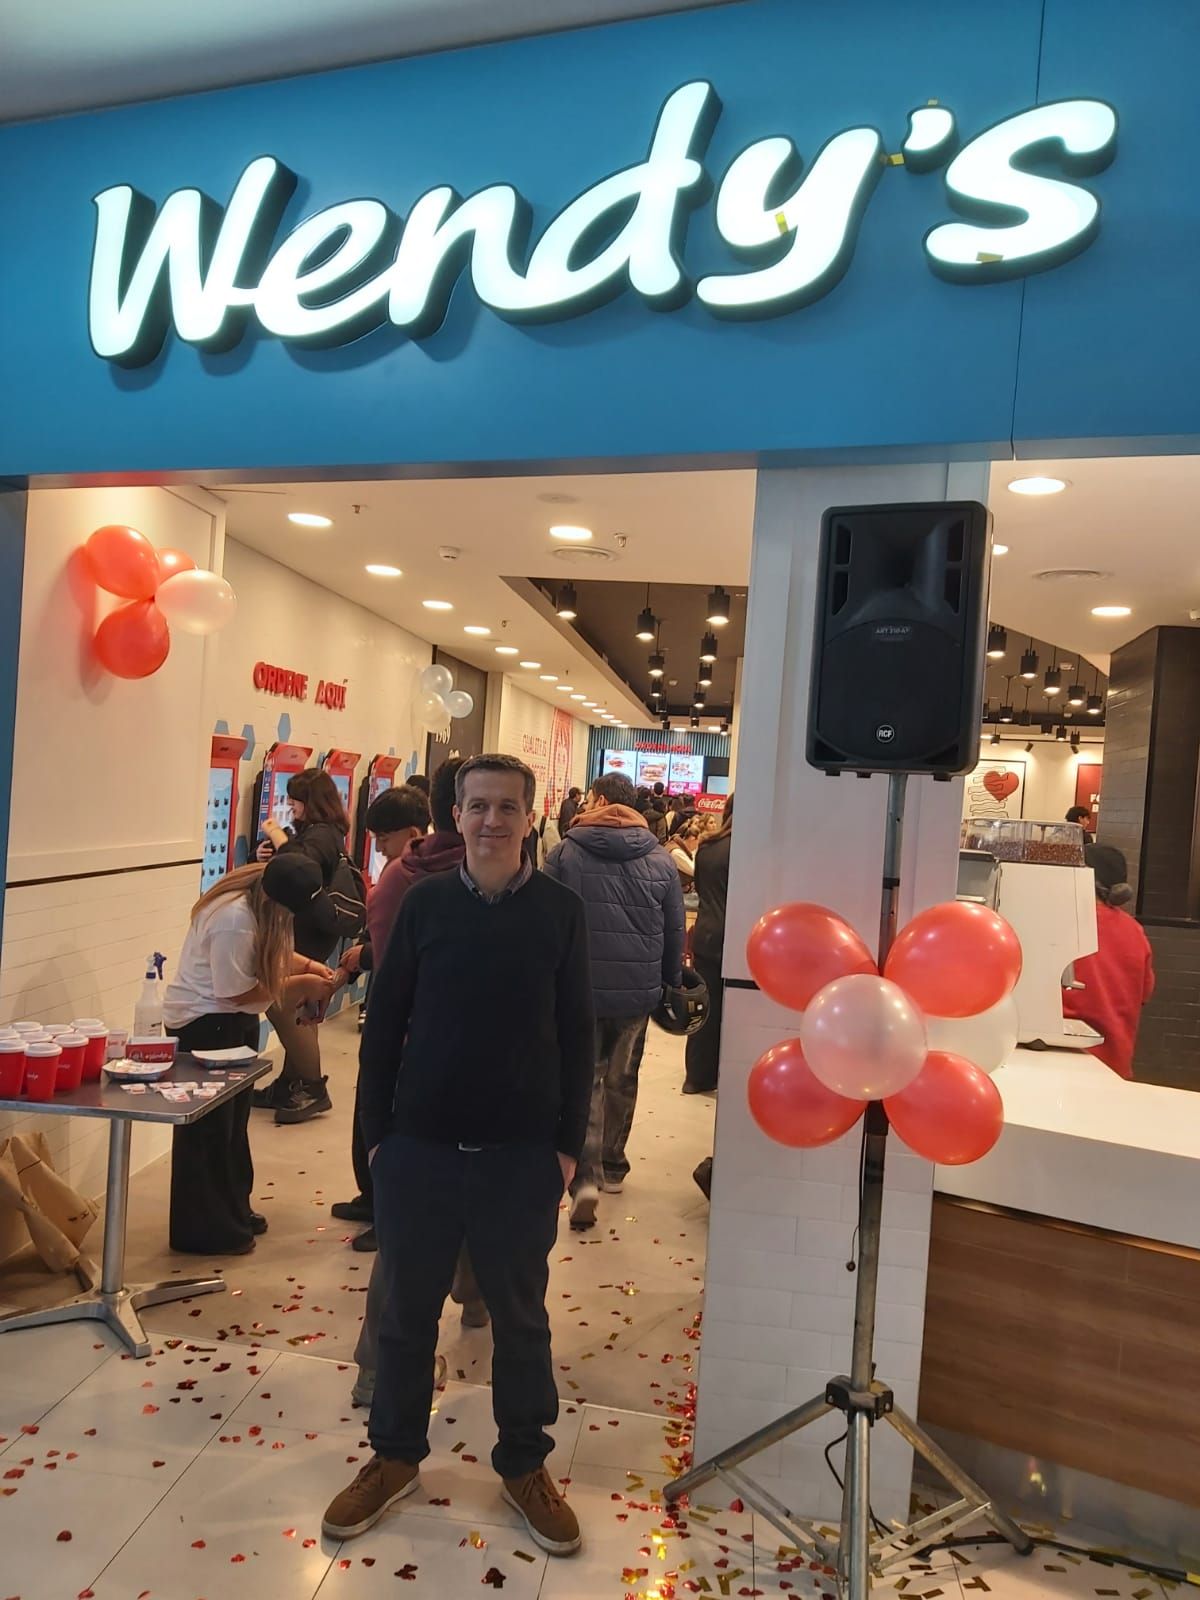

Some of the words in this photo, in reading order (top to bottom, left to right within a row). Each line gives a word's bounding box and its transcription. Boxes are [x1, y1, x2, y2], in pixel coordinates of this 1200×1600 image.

[88, 80, 1118, 358] Wendy's
[253, 661, 309, 701] ORDENE
[314, 679, 349, 712] AQUÍ
